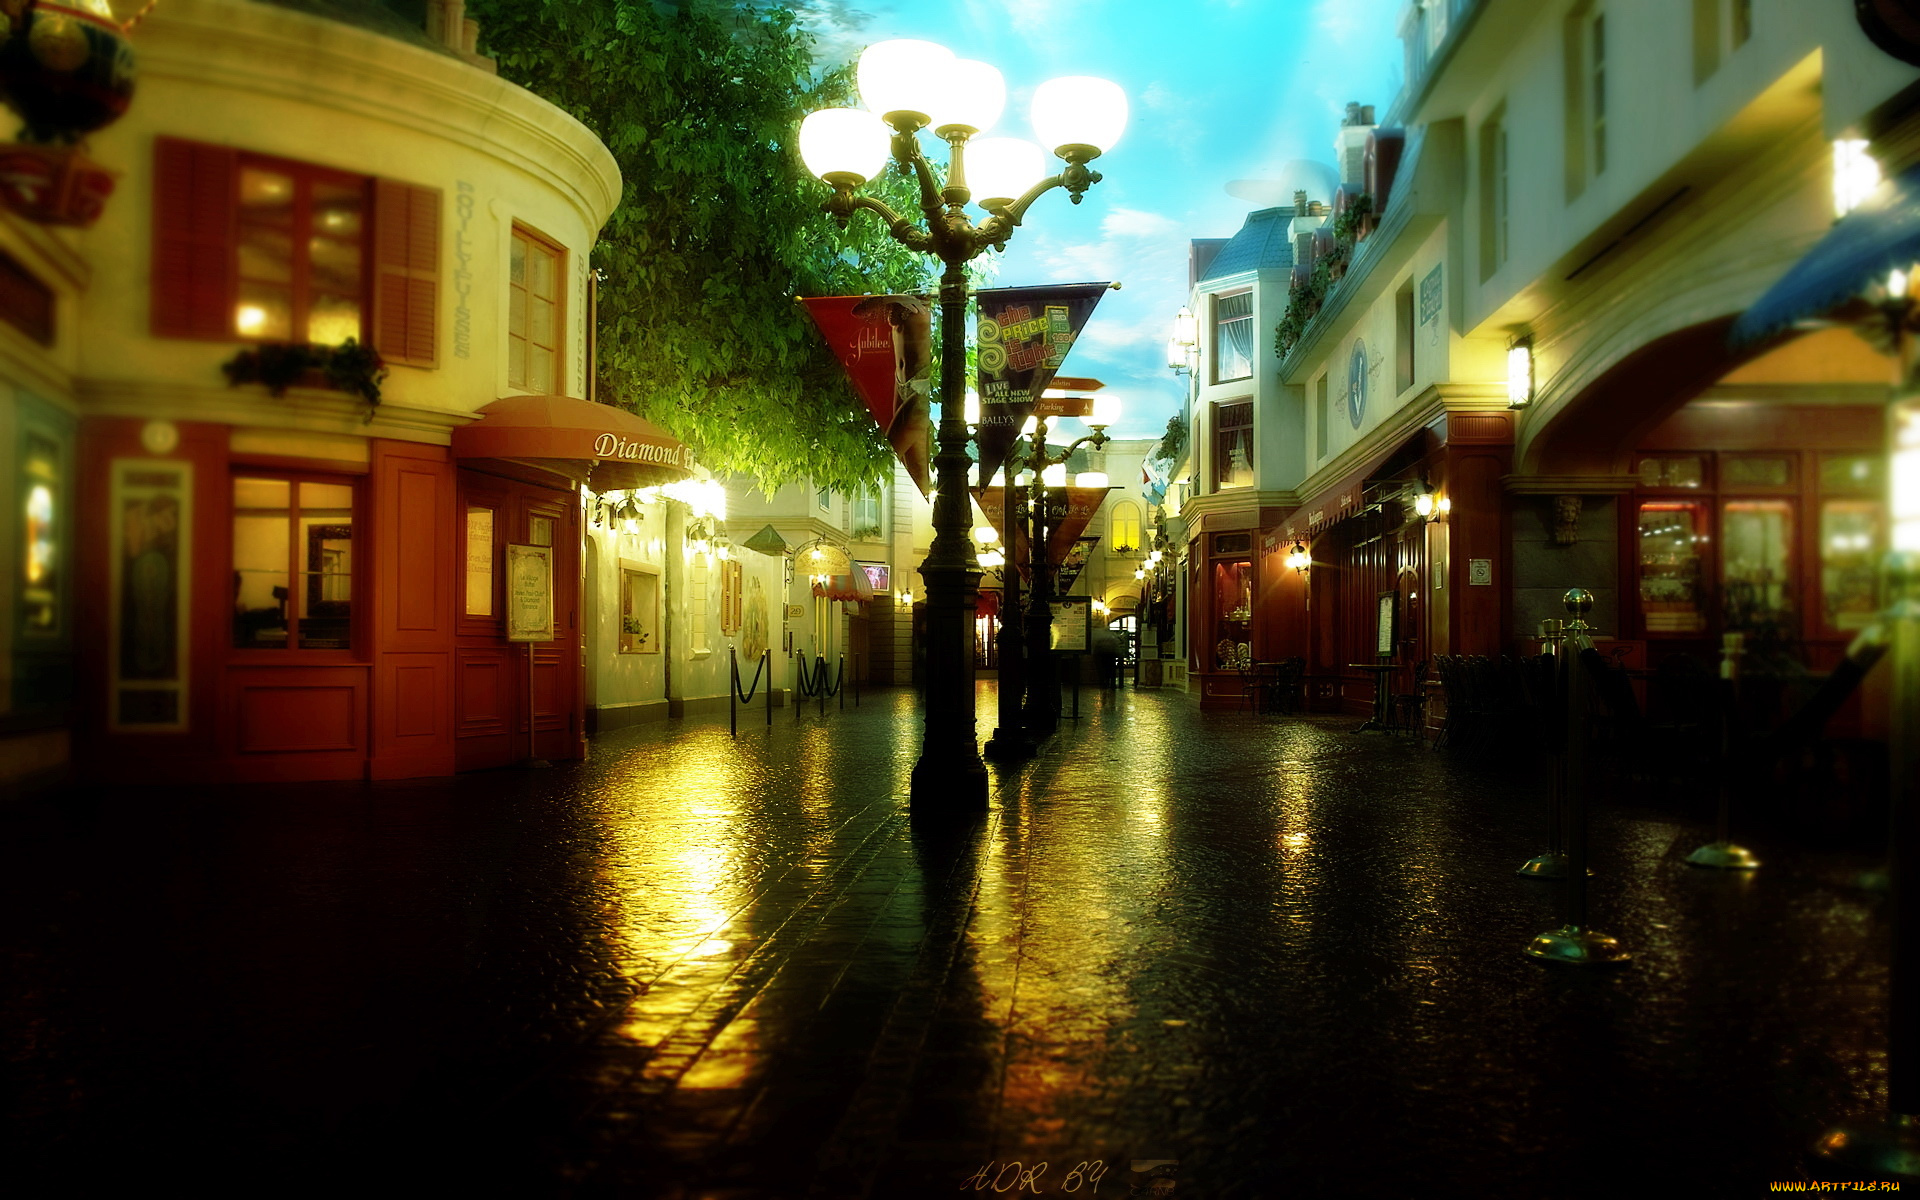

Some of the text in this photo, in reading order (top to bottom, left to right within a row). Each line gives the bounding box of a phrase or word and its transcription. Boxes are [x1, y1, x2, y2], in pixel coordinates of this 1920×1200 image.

[997, 305, 1031, 327] the
[845, 327, 891, 367] Jubilee!
[1004, 338, 1022, 355] is
[1007, 341, 1057, 372] Right
[984, 381, 1010, 397] LIVE
[994, 389, 1030, 398] ALL NEW
[981, 396, 1034, 405] STAGE SHOW
[1039, 403, 1064, 412] Parking
[981, 414, 1015, 425] BALLY'S
[594, 432, 684, 466] Diamond
